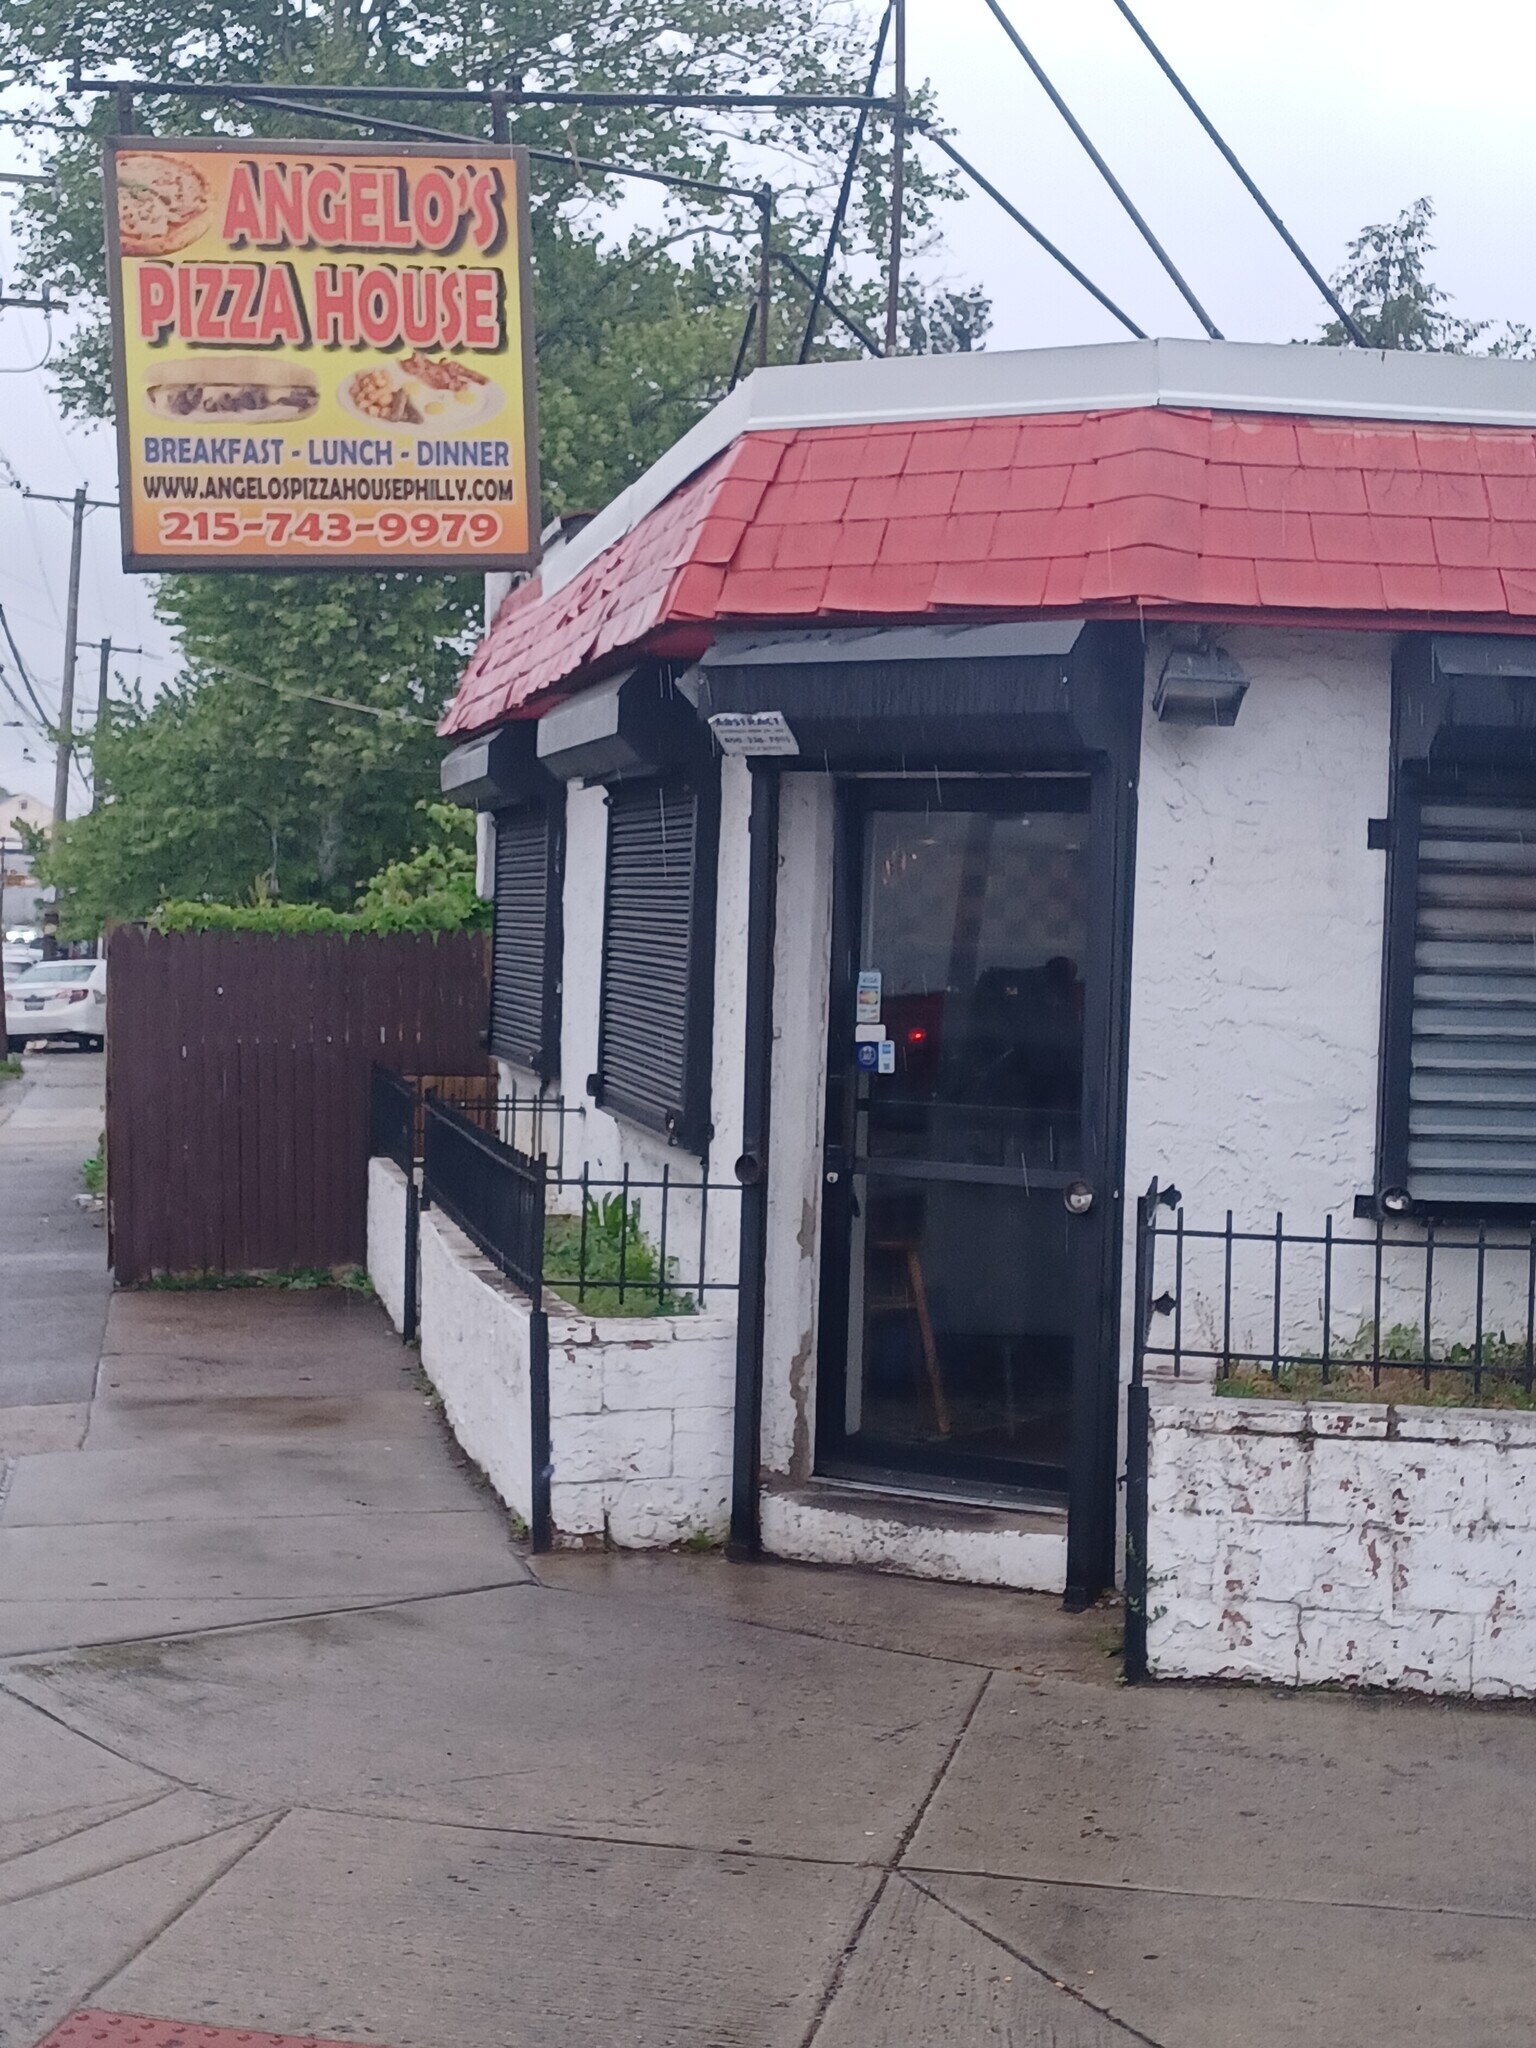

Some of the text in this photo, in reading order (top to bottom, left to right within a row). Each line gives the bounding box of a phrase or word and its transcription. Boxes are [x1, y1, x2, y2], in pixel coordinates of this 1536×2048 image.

[222, 163, 507, 256] ANGELO'S
[138, 263, 508, 353] PIZZA HOUSE
[144, 437, 285, 465] BREAKFAST
[308, 439, 395, 466] LUNCH
[417, 441, 511, 467] DINNER
[143, 476, 515, 501] WWW.ANGELOSPIZZAHOUSEPHILLY.COM
[162, 511, 499, 542] 215-743-9979
